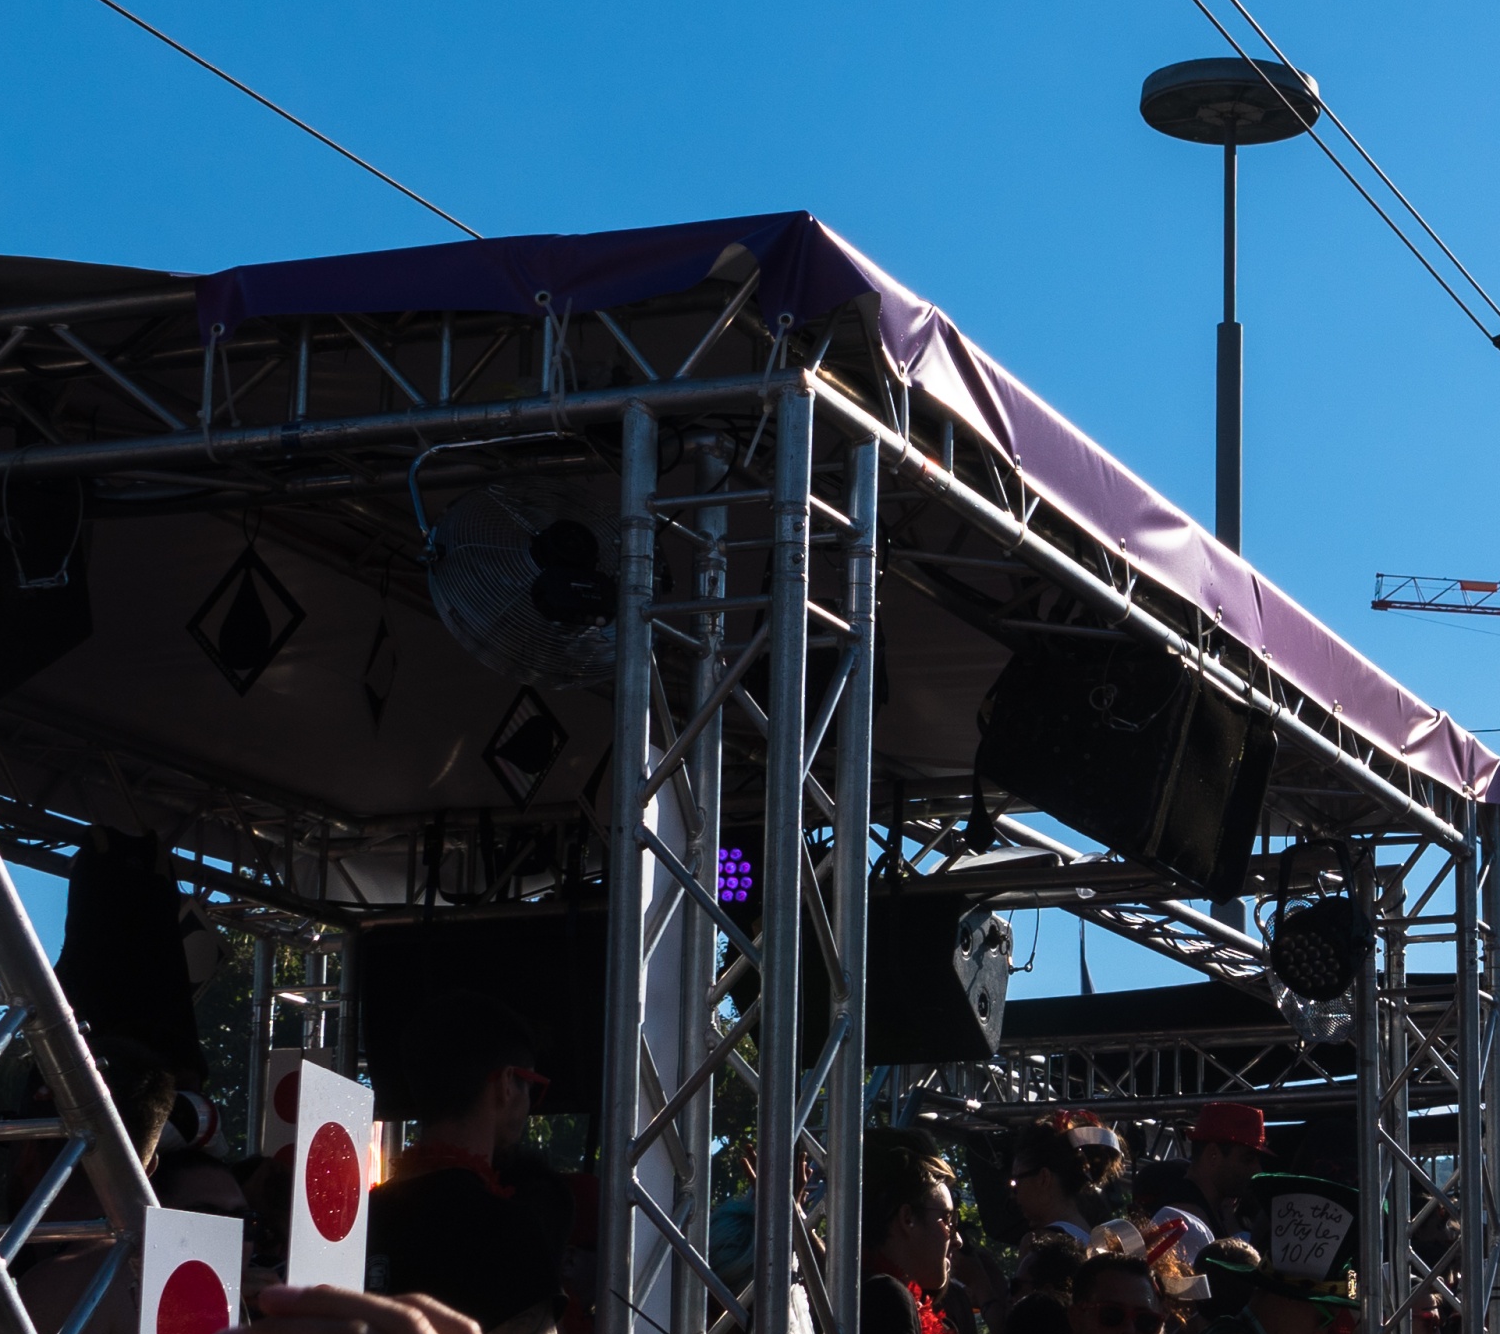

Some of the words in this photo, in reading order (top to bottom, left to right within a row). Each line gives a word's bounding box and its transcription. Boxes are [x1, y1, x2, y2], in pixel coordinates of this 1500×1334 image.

[1310, 1203, 1342, 1223] this
[1274, 1219, 1340, 1241] Style
[1281, 1242, 1329, 1264] 10/6
